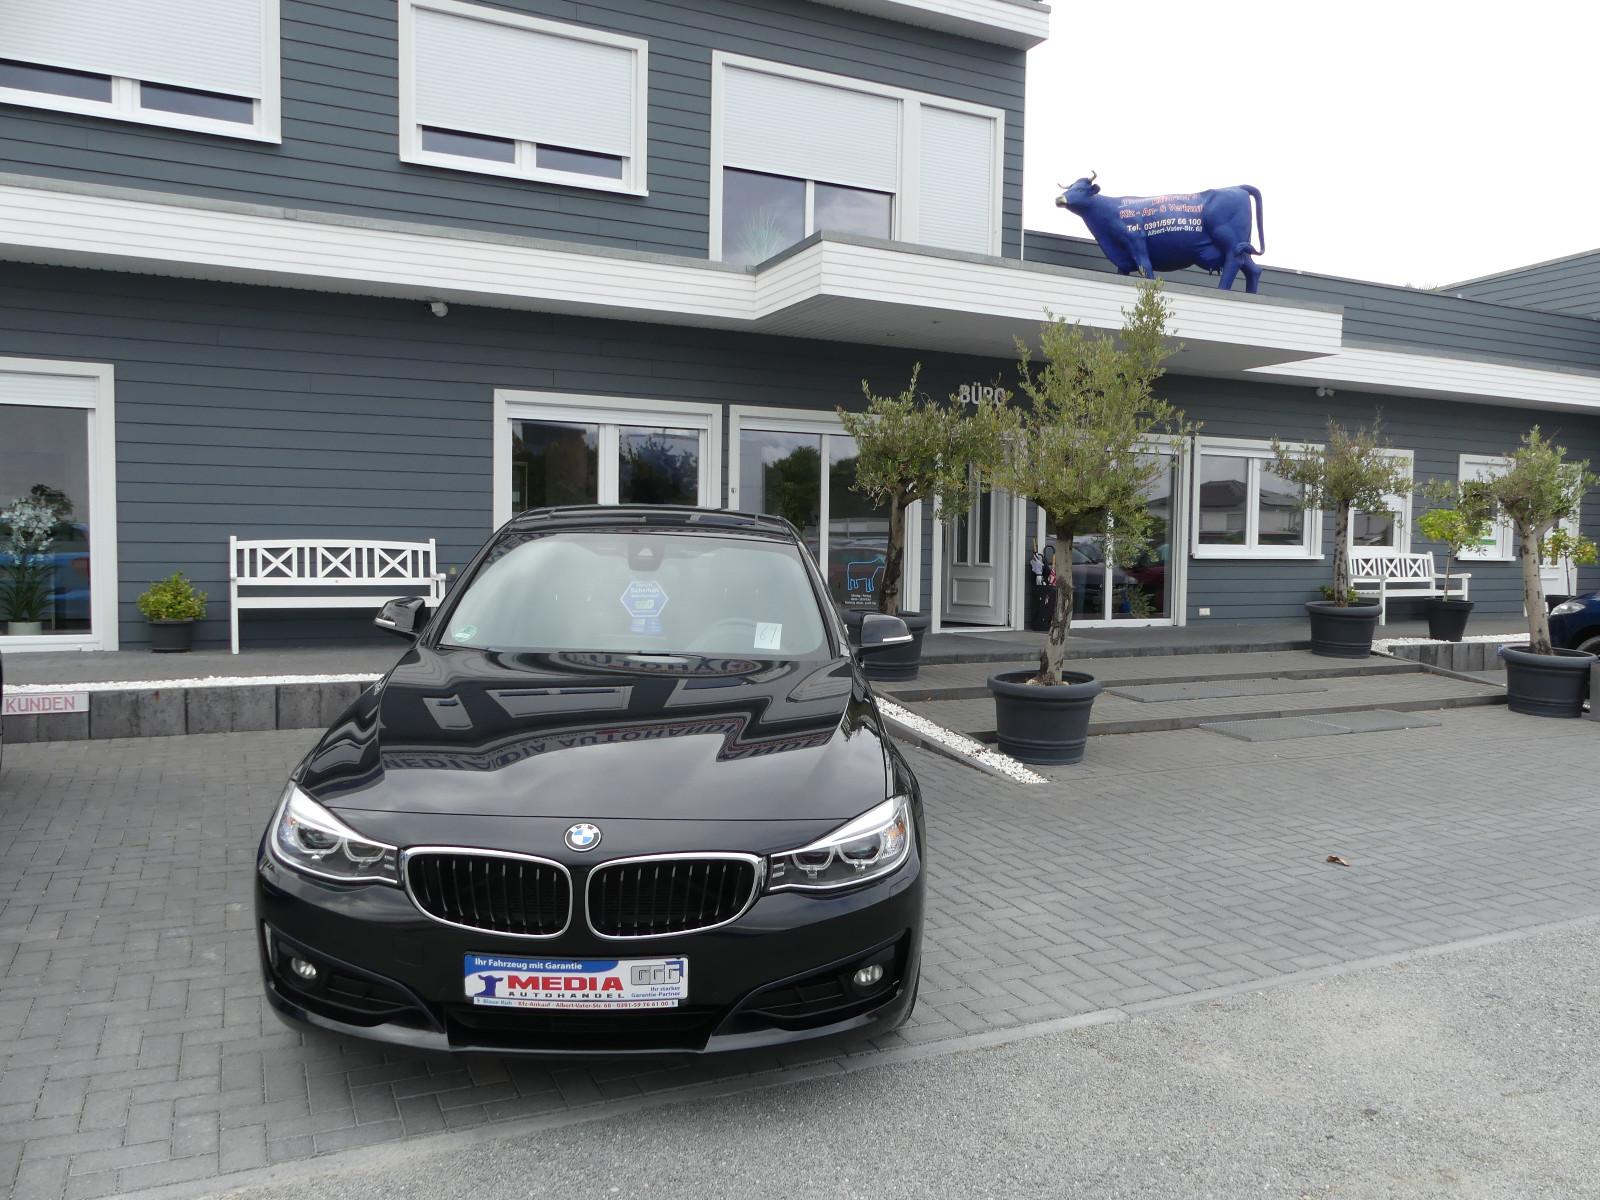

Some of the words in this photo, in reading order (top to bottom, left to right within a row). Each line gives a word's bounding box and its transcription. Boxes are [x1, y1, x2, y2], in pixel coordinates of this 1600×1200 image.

[1126, 224, 1141, 233] Tel.
[1143, 218, 1176, 231] 0391/597
[1188, 218, 1202, 226] 100
[5, 695, 75, 712] KUNDEN
[474, 957, 487, 966] Ihr
[488, 958, 528, 970] Fahrzeug
[528, 961, 544, 969] mit
[545, 961, 583, 970] Garantie
[507, 974, 624, 991] MEDIA
[508, 991, 625, 999] AUTOHANDEL
